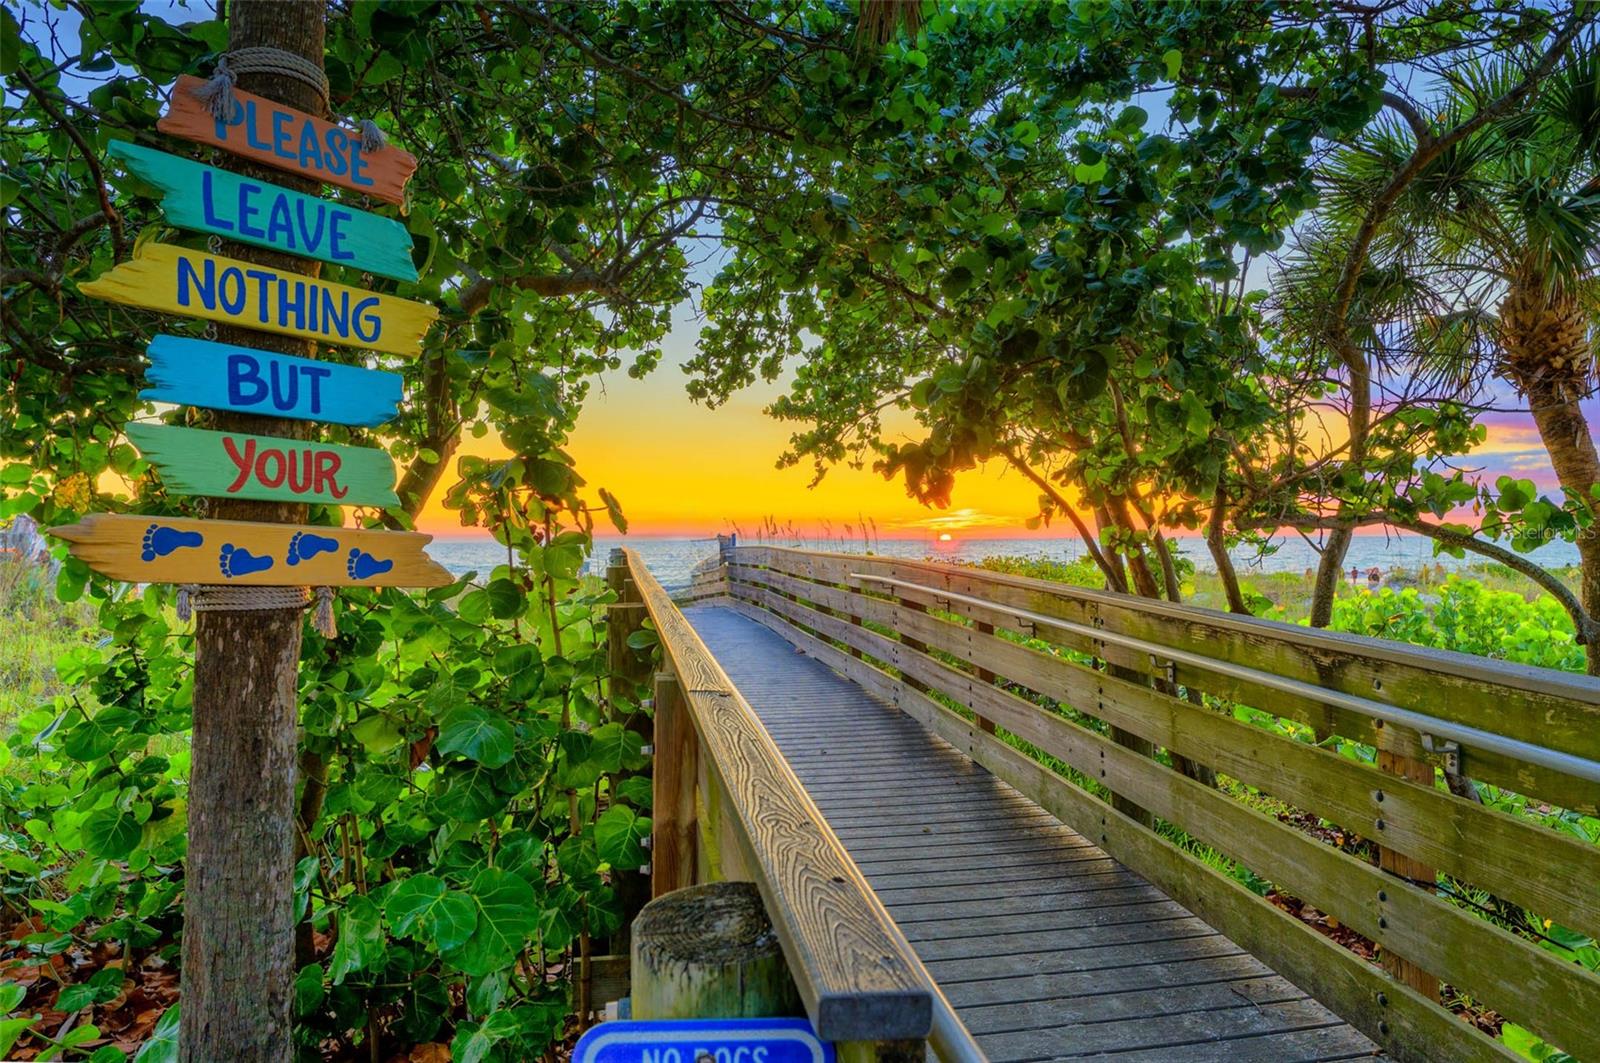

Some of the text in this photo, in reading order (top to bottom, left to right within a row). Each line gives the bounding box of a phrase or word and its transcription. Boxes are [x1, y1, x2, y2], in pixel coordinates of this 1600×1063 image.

[214, 98, 375, 186] PLEASE
[202, 170, 355, 260] LEAVE
[177, 256, 382, 343] NOTHING
[227, 354, 331, 414] BUT
[222, 436, 349, 499] YOUR
